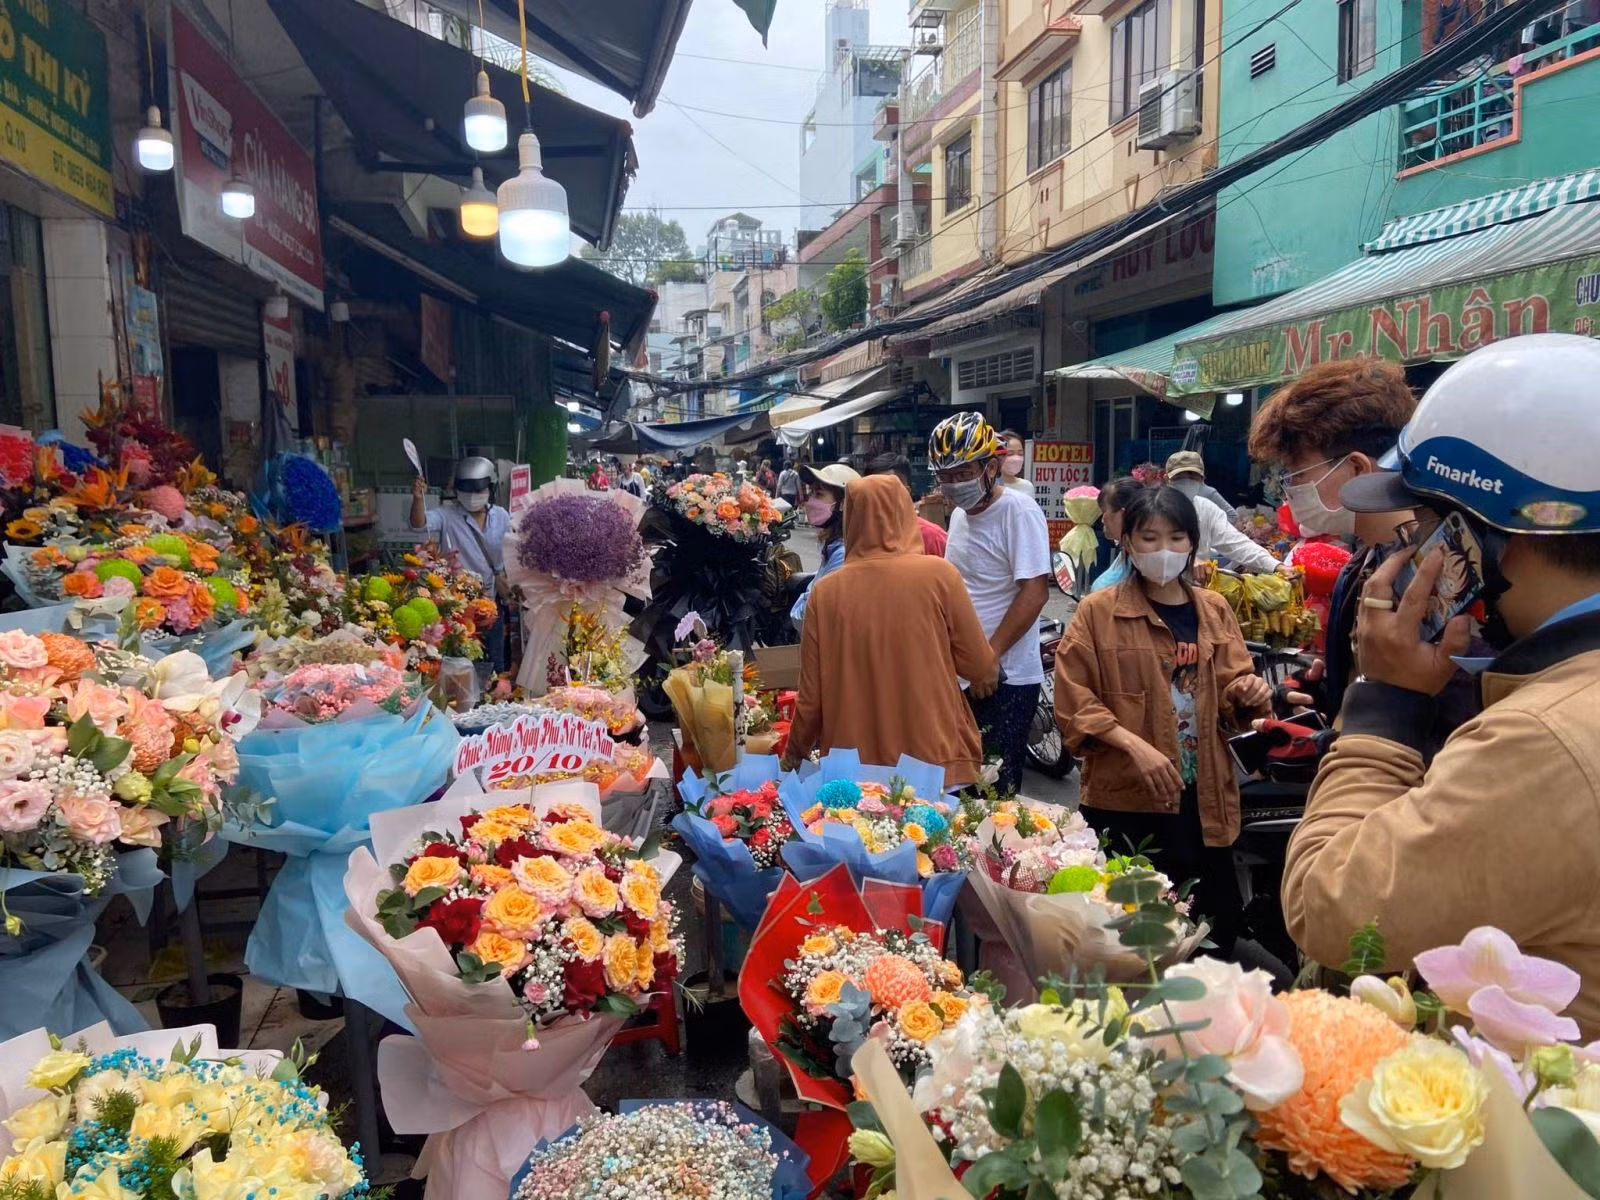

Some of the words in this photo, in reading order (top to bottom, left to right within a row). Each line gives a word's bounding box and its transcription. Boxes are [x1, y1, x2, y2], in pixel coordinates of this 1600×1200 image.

[1035, 444, 1091, 462] HOTEL
[1035, 467, 1057, 482] HUY
[1060, 464, 1080, 486] LỘC
[1082, 466, 1090, 482] 2
[1425, 455, 1505, 495] Fmarket
[457, 739, 483, 774] Chúc
[483, 726, 513, 759] Mừng
[513, 717, 540, 755] Ngày
[592, 726, 613, 758] Nam
[487, 752, 583, 781] 20/10
